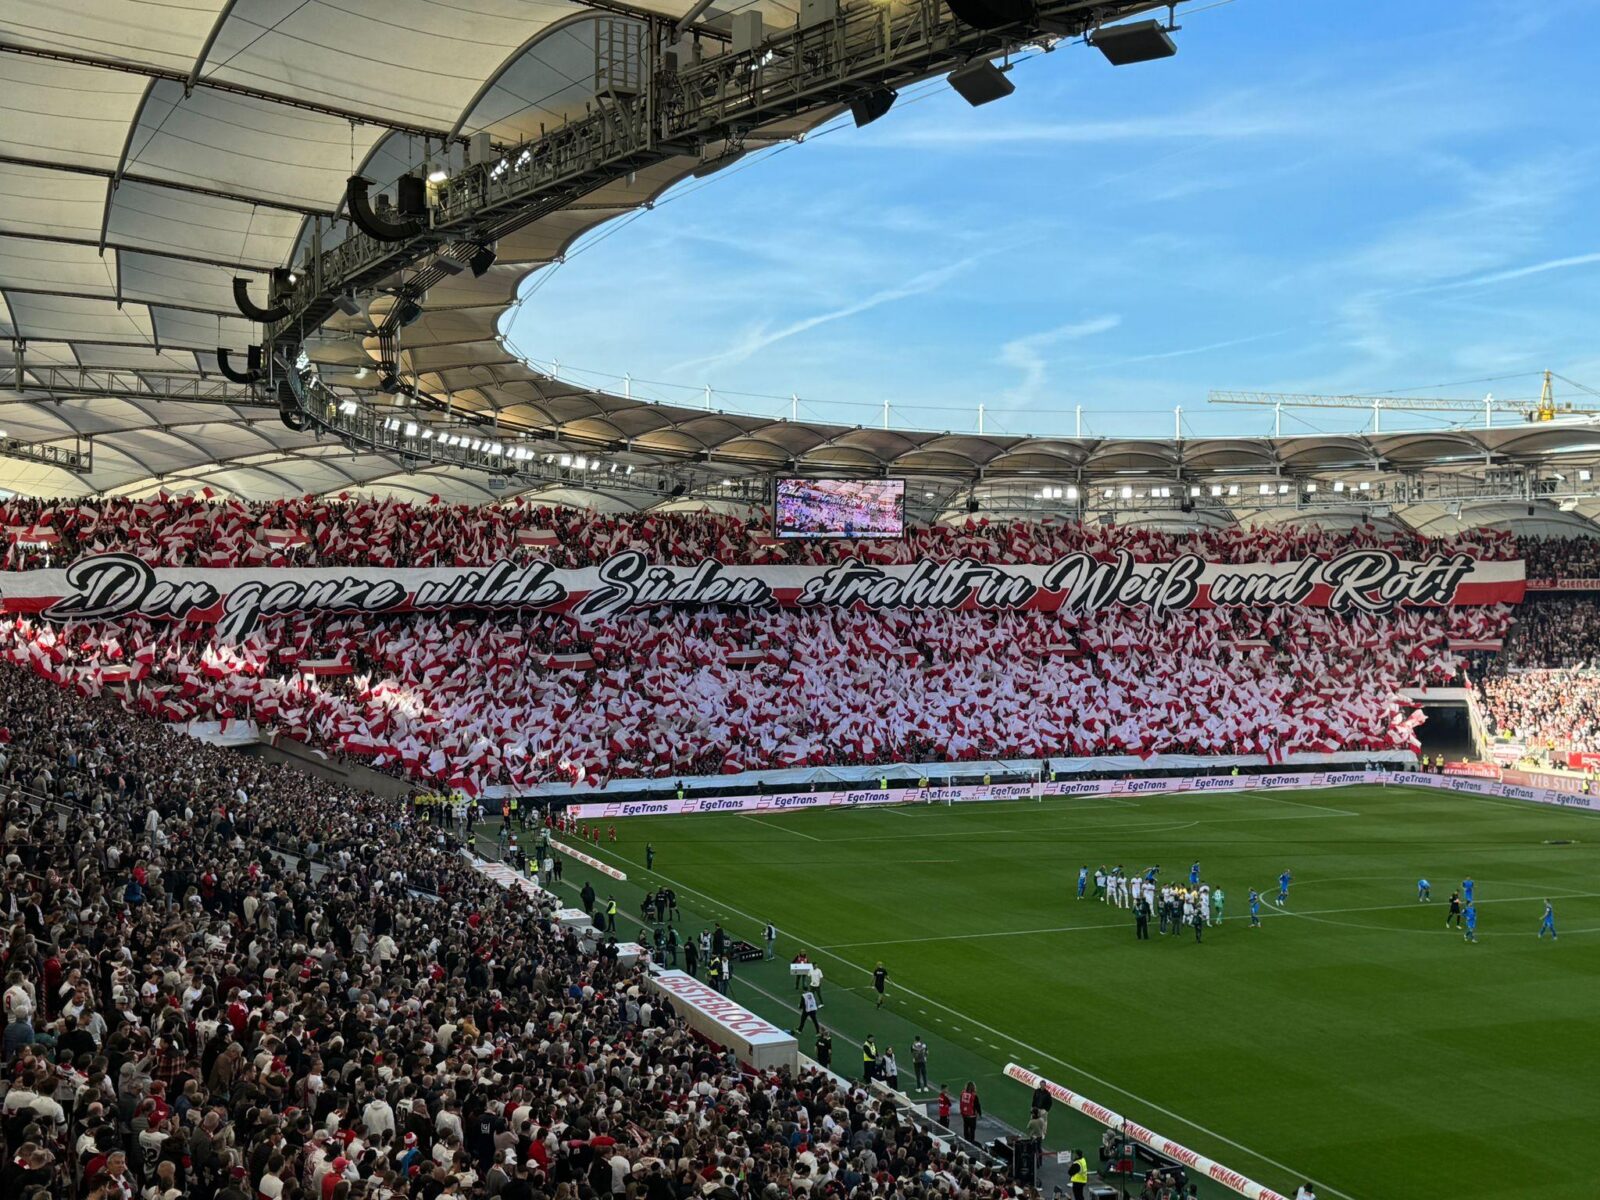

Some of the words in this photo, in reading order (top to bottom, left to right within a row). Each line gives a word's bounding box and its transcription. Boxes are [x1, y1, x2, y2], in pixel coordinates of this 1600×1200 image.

[41, 553, 219, 622] Der
[220, 577, 408, 642] ganze
[412, 558, 568, 610] wilde
[796, 557, 990, 609] strahlt
[975, 569, 1037, 609] in
[1043, 550, 1205, 619] Weiß
[1208, 553, 1323, 608] und
[1321, 550, 1474, 615] Rot!
[1195, 778, 1234, 789] EgeTrans
[1261, 776, 1299, 787] EgeTrans
[1393, 773, 1432, 784] EgeTrans
[1452, 778, 1481, 792] EgeTrans
[1059, 783, 1099, 794] EgeTrans
[1126, 781, 1167, 791] EgeTrans
[1502, 785, 1534, 798] EgeTrans
[774, 794, 818, 807] EgeTrans
[848, 792, 889, 803] EgeTrans
[1557, 793, 1590, 807] EgeTrans
[622, 802, 668, 815] EgeTrans
[700, 798, 743, 811] EgeTrans
[1163, 1141, 1199, 1168] WINAMAX
[1209, 1163, 1249, 1193] WINAMAX
